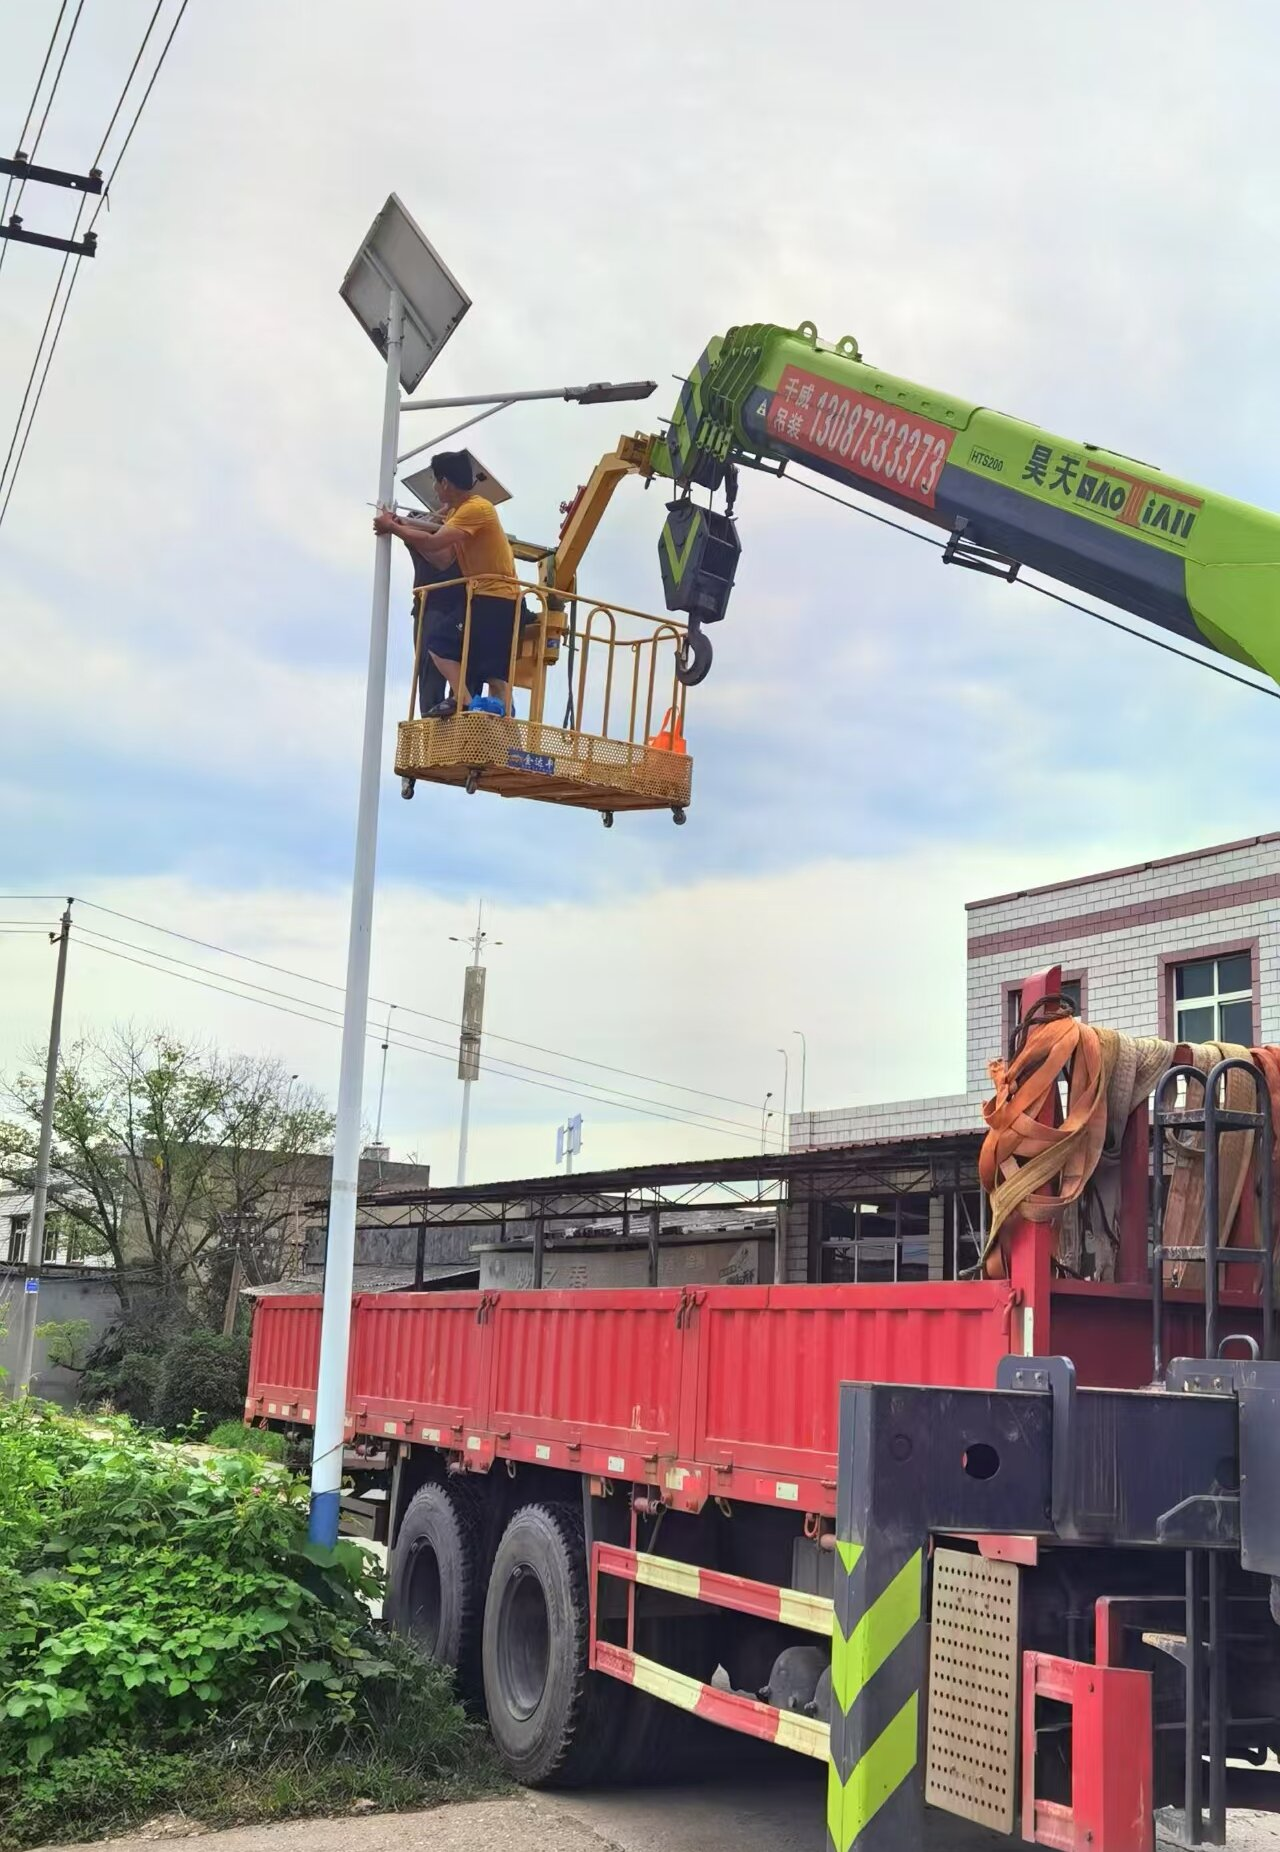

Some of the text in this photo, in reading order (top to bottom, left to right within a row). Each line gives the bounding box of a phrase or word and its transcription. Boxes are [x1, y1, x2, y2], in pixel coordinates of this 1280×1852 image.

[773, 407, 804, 440] 吊装
[808, 391, 946, 495] 13087333373
[971, 450, 1004, 472] HTS200
[1021, 444, 1081, 496] 昊天
